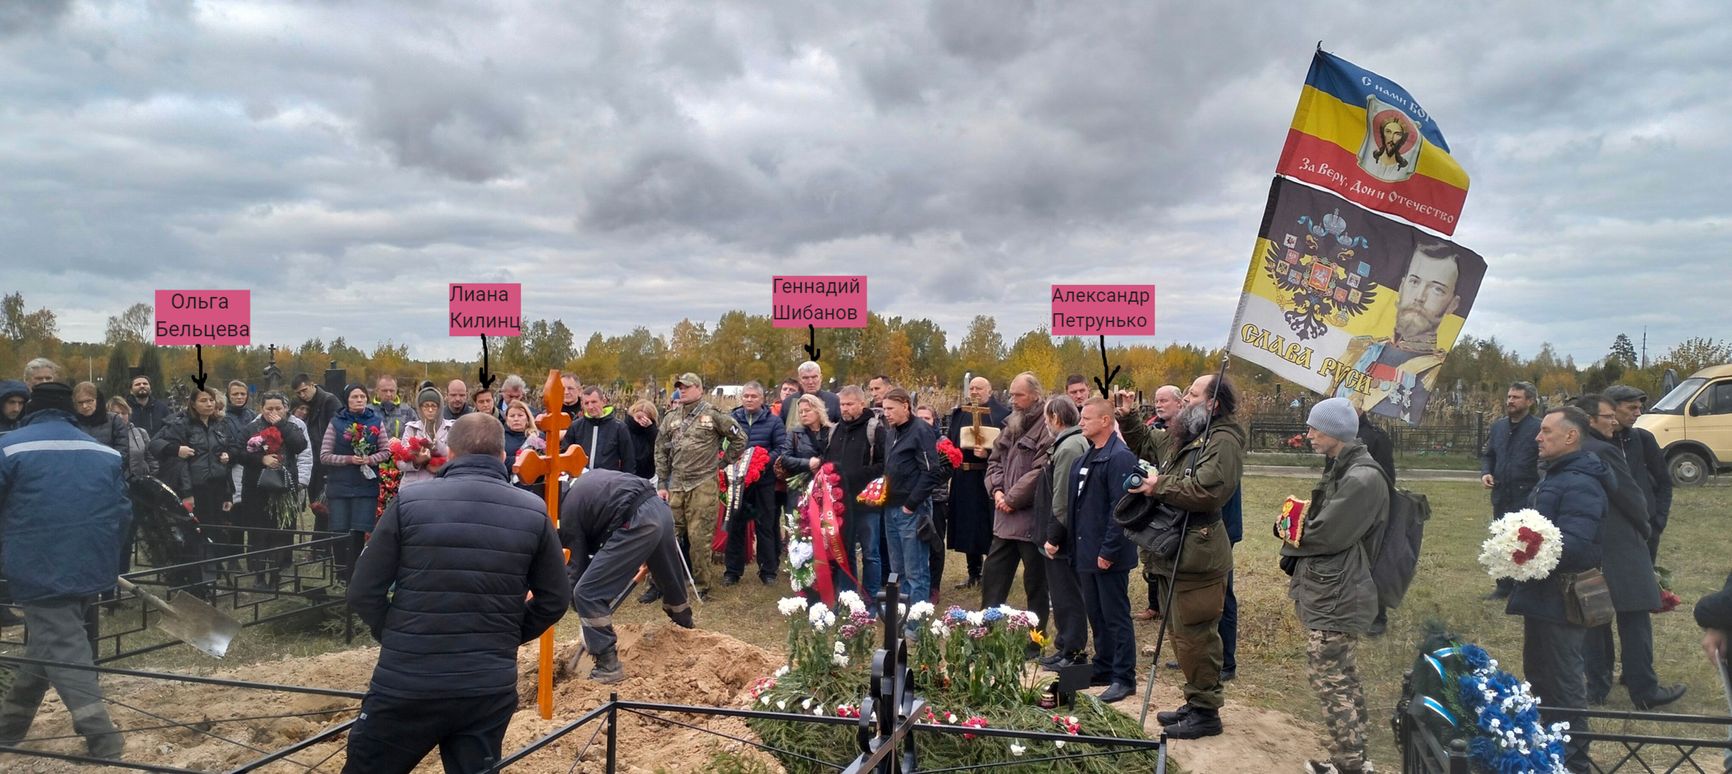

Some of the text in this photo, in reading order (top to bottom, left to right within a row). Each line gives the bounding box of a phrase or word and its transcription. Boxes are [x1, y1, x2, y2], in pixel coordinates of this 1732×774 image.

[1361, 76, 1372, 86] С
[1375, 84, 1406, 105] нами
[1299, 157, 1315, 172] За
[1318, 163, 1348, 187] Веру,
[1350, 180, 1375, 197] Дон
[1377, 191, 1385, 200] и
[1241, 323, 1375, 396] СЛАВА РУСИ
